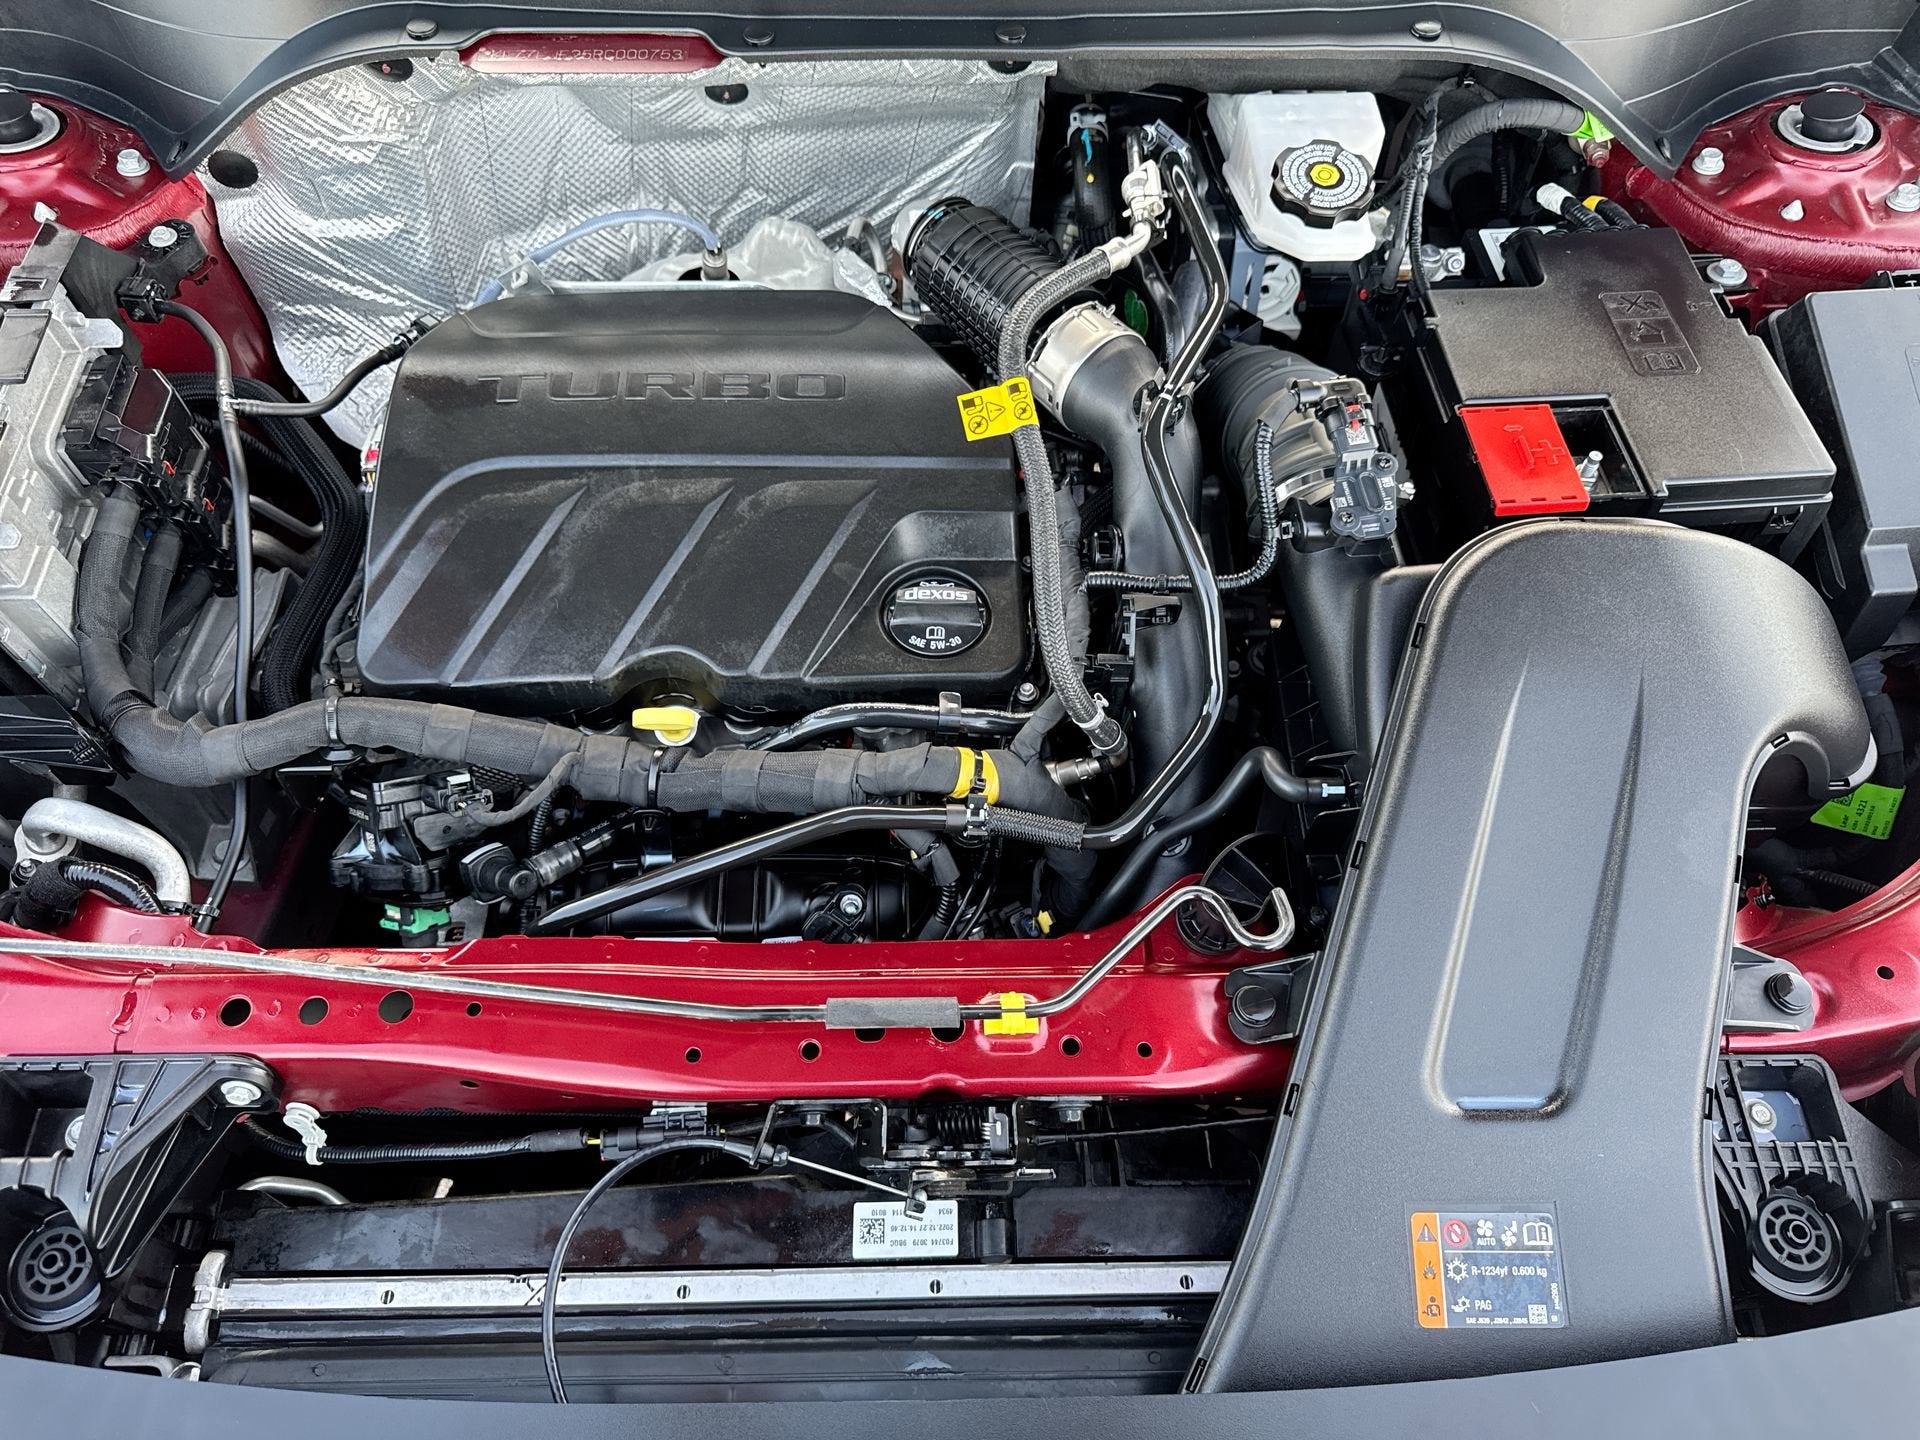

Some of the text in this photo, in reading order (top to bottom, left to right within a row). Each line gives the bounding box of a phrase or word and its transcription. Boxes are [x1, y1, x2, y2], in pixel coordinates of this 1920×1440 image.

[478, 371, 846, 403] TURBO
[904, 587, 968, 601] dexos
[908, 635, 962, 650] SAE 5W-30
[1856, 800, 1868, 817] 4321
[1476, 1237, 1496, 1246] AUTO
[1471, 1266, 1548, 1278] R-1234yf 0.600 kg
[1474, 1299, 1492, 1310] PAG
